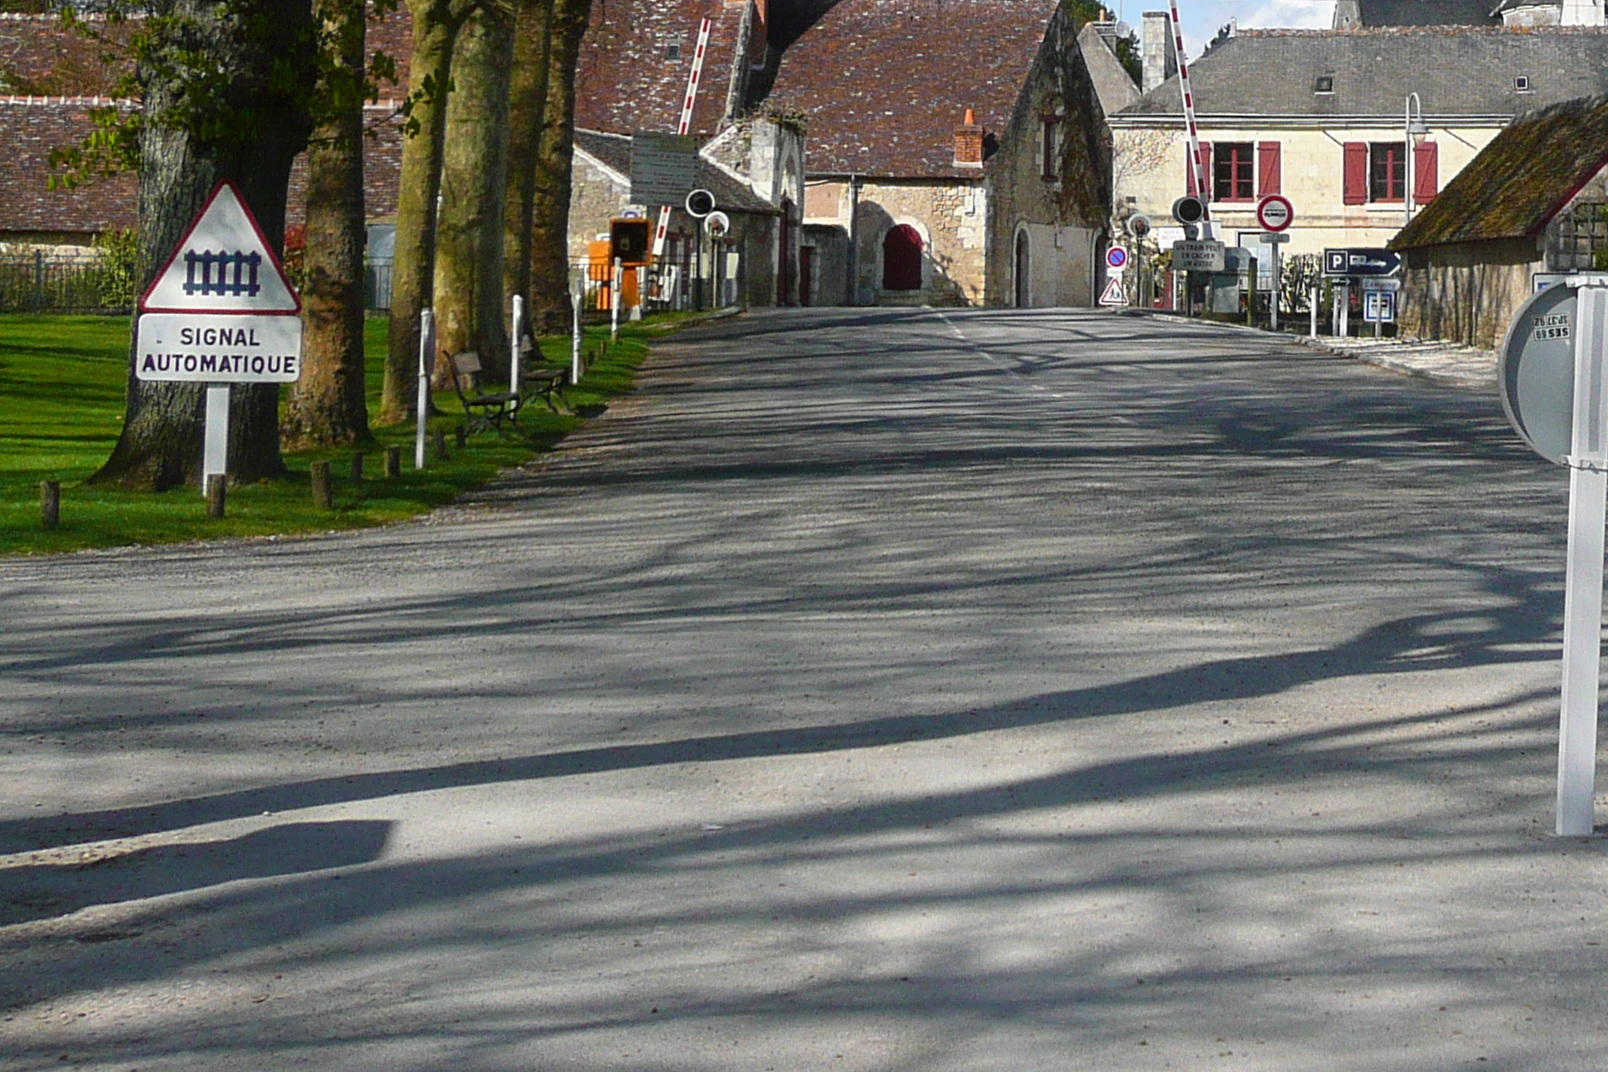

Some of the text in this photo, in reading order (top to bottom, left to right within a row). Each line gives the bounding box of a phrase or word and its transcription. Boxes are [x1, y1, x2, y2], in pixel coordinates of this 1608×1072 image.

[1332, 255, 1343, 269] P
[180, 327, 260, 346] SIGNAL
[1548, 328, 1568, 337] SES
[141, 353, 296, 374] AUTOMATIQUE
